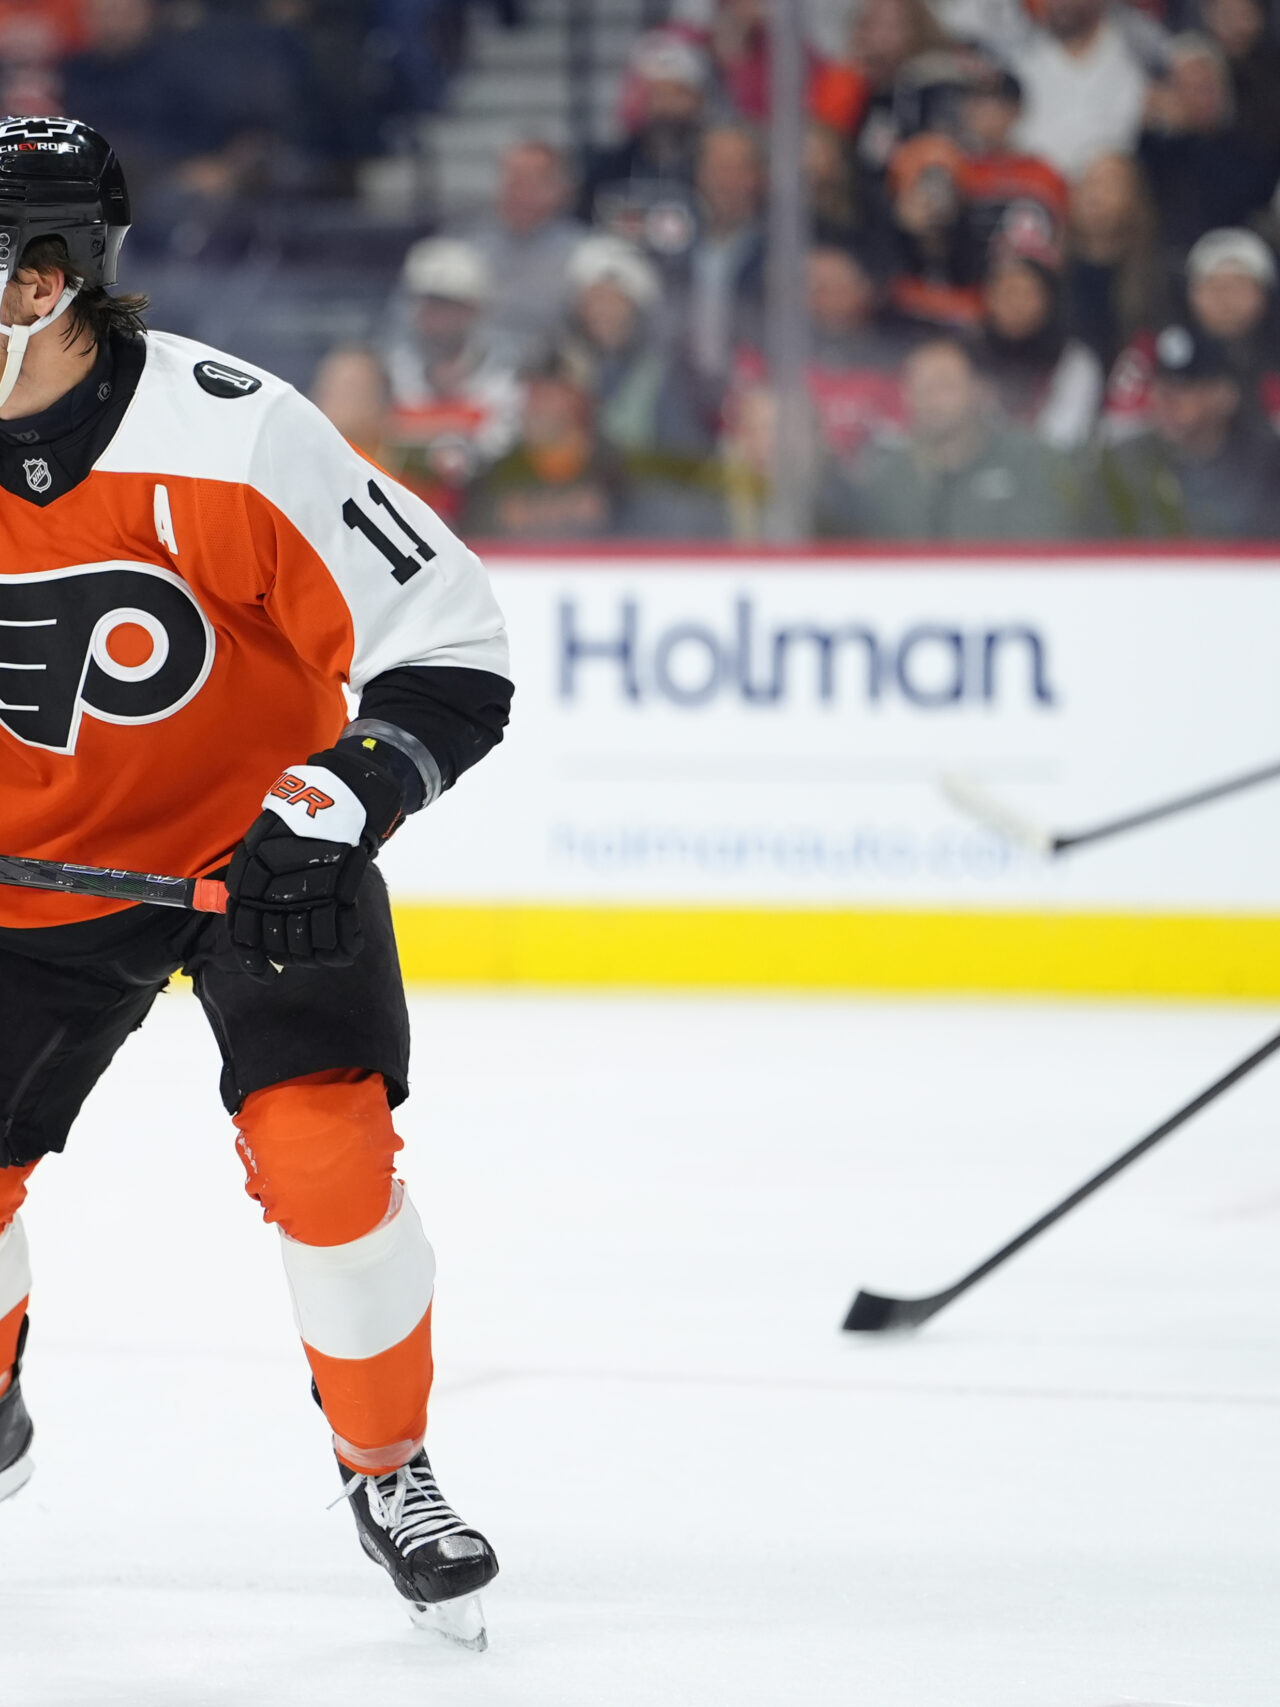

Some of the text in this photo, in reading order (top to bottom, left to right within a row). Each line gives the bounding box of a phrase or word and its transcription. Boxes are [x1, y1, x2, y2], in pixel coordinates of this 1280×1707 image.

[153, 483, 179, 556] A
[342, 479, 437, 586] 11
[556, 593, 1058, 709] Holman
